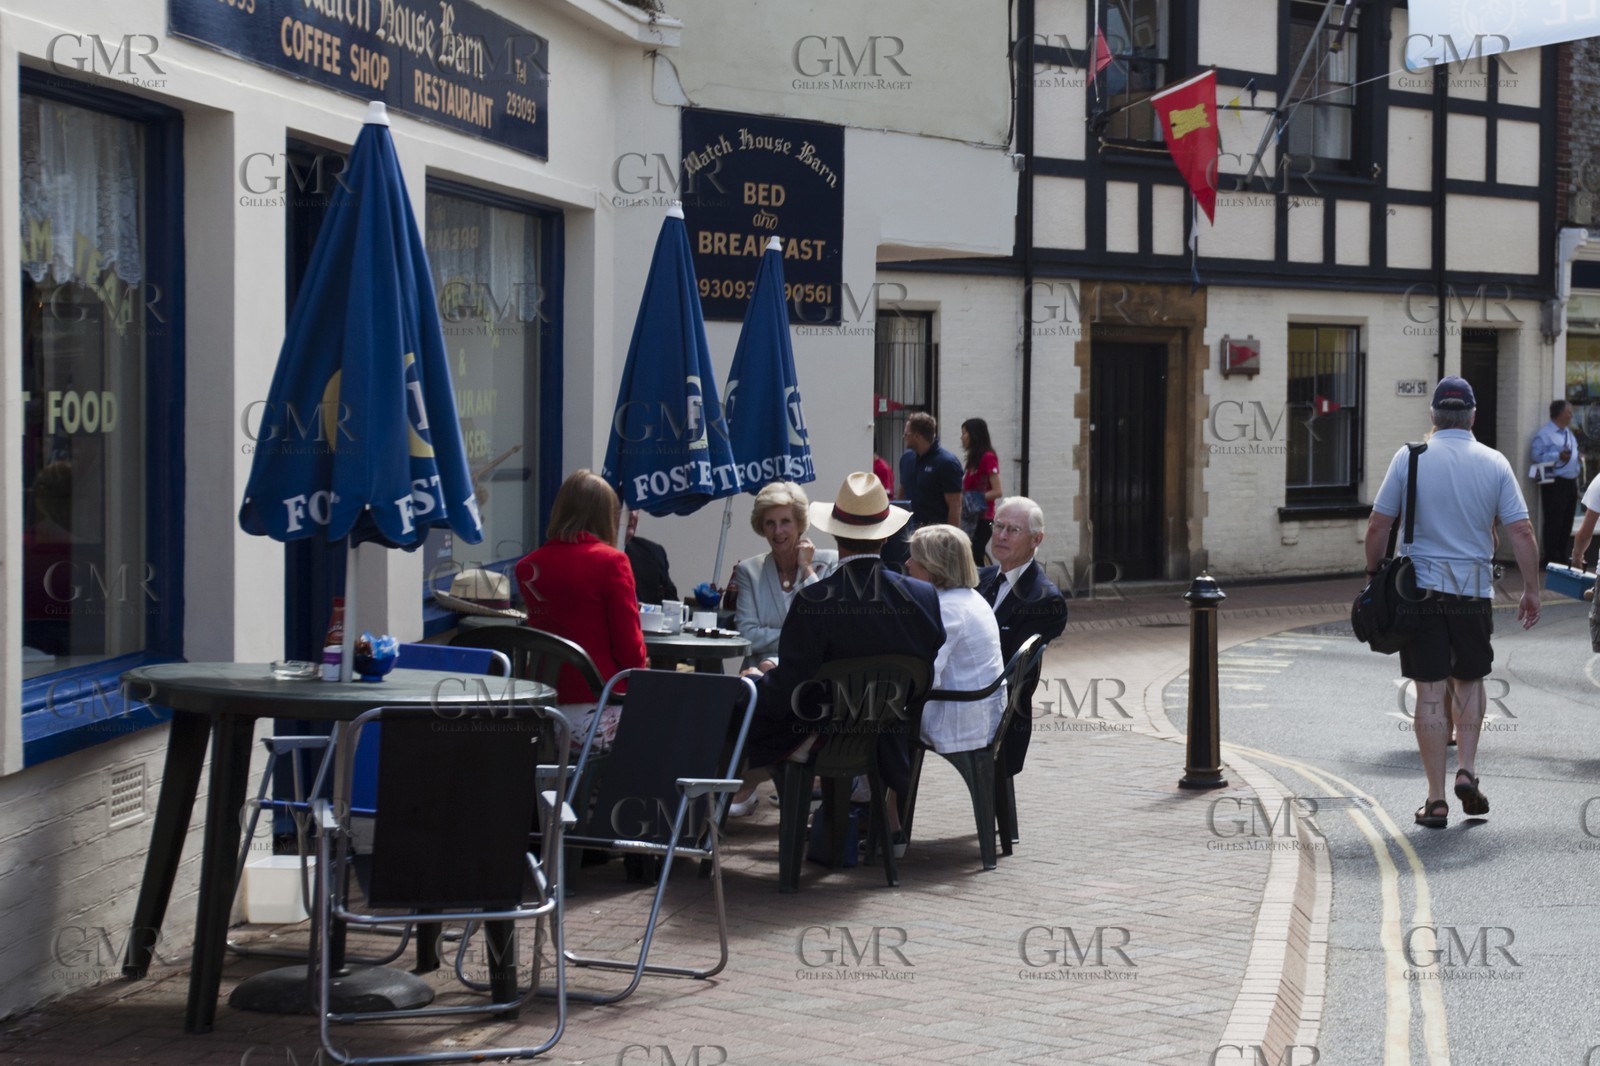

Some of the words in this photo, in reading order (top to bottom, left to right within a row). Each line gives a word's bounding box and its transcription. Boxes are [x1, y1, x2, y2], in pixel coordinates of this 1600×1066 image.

[280, 16, 342, 75] COFFEE
[350, 43, 390, 91] SHOP
[439, 1, 486, 80] Barn
[515, 58, 527, 85] Tel
[414, 69, 494, 129] RESTAURANT
[506, 90, 537, 124] 293093
[682, 134, 733, 174] Watch
[737, 128, 792, 154] House
[795, 140, 838, 189] Barn
[743, 181, 786, 207] BED
[752, 208, 779, 230] and
[698, 230, 826, 261] BREAKAST
[697, 278, 755, 300] 93093
[1398, 382, 1416, 394] HIGH
[47, 390, 118, 435] FOOD
